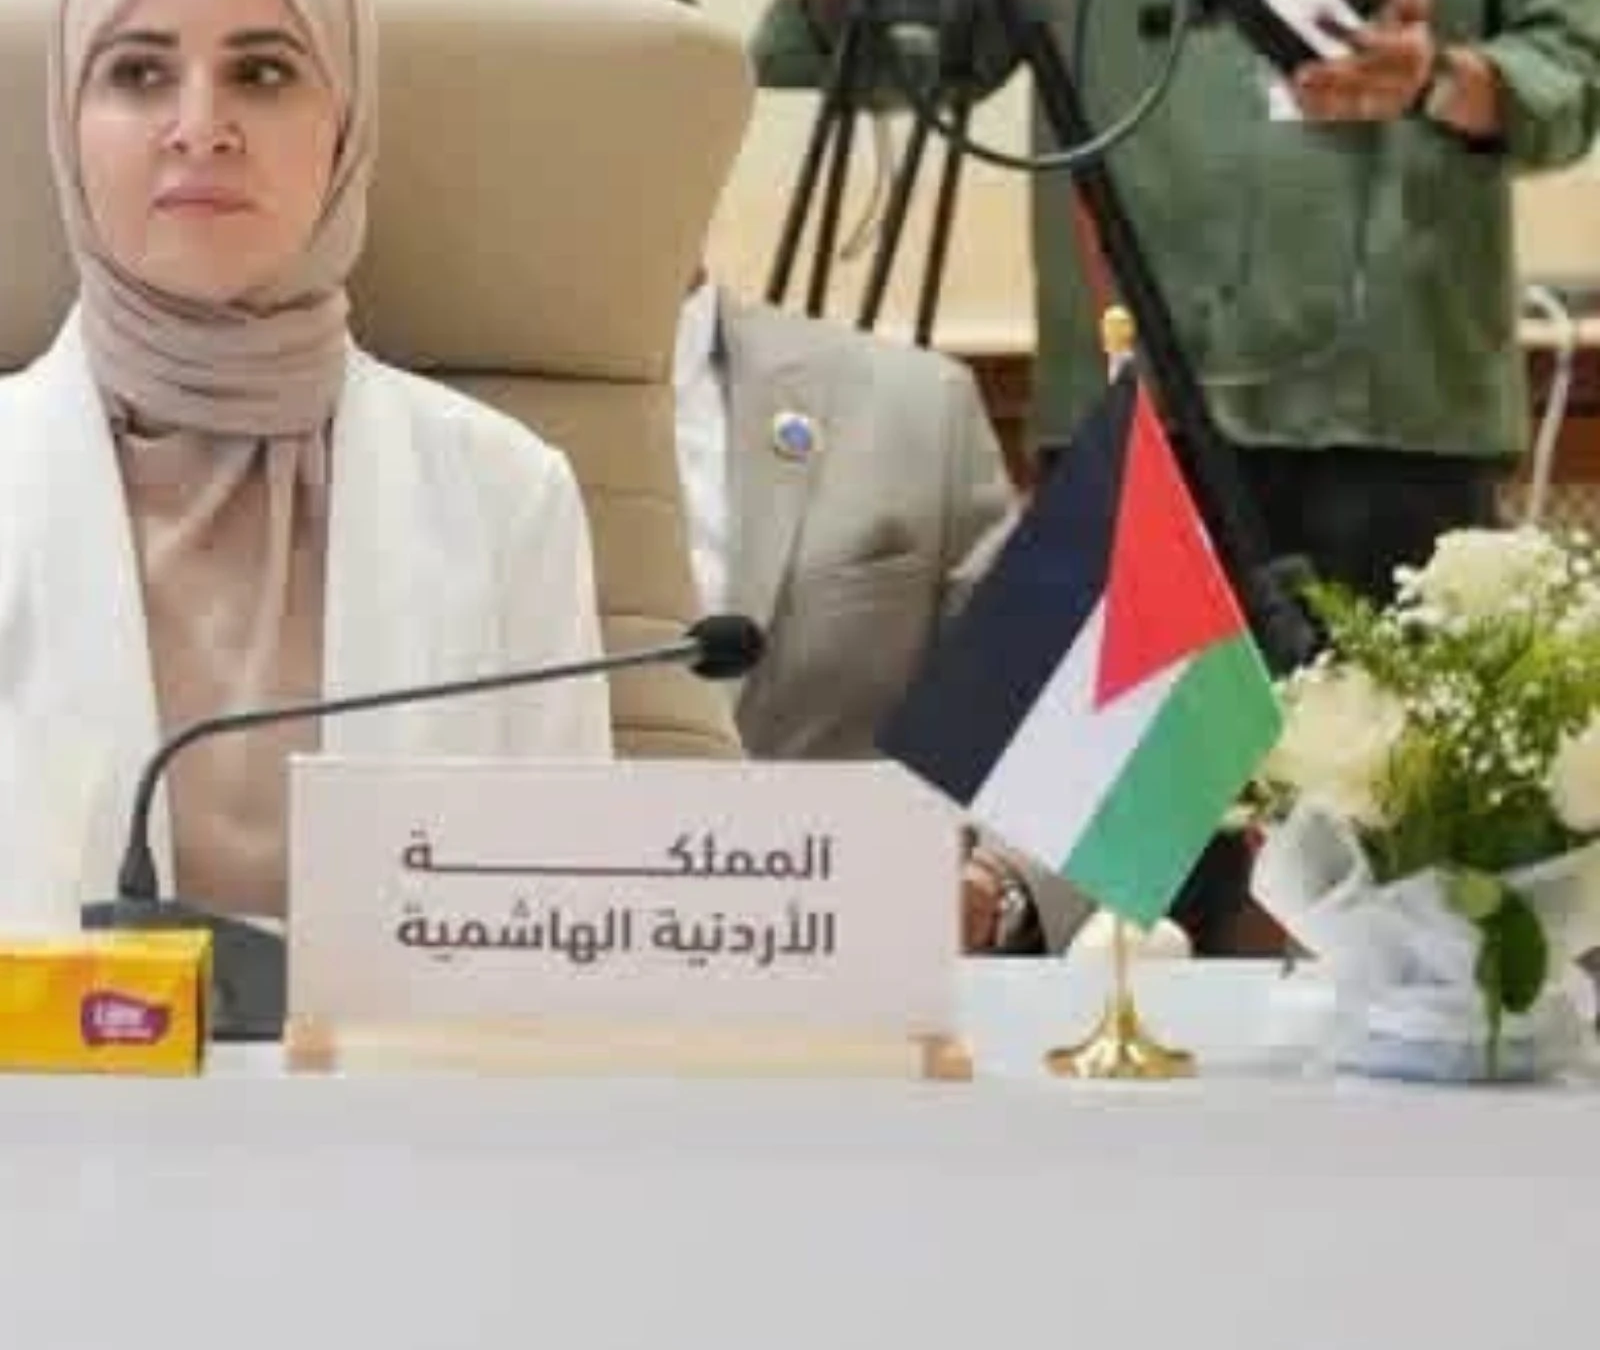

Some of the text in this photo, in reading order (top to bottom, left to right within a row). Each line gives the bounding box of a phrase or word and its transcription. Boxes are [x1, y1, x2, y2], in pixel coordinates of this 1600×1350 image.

[400, 830, 833, 881] المملكة
[395, 899, 836, 969] الأردنية الهاشمية
